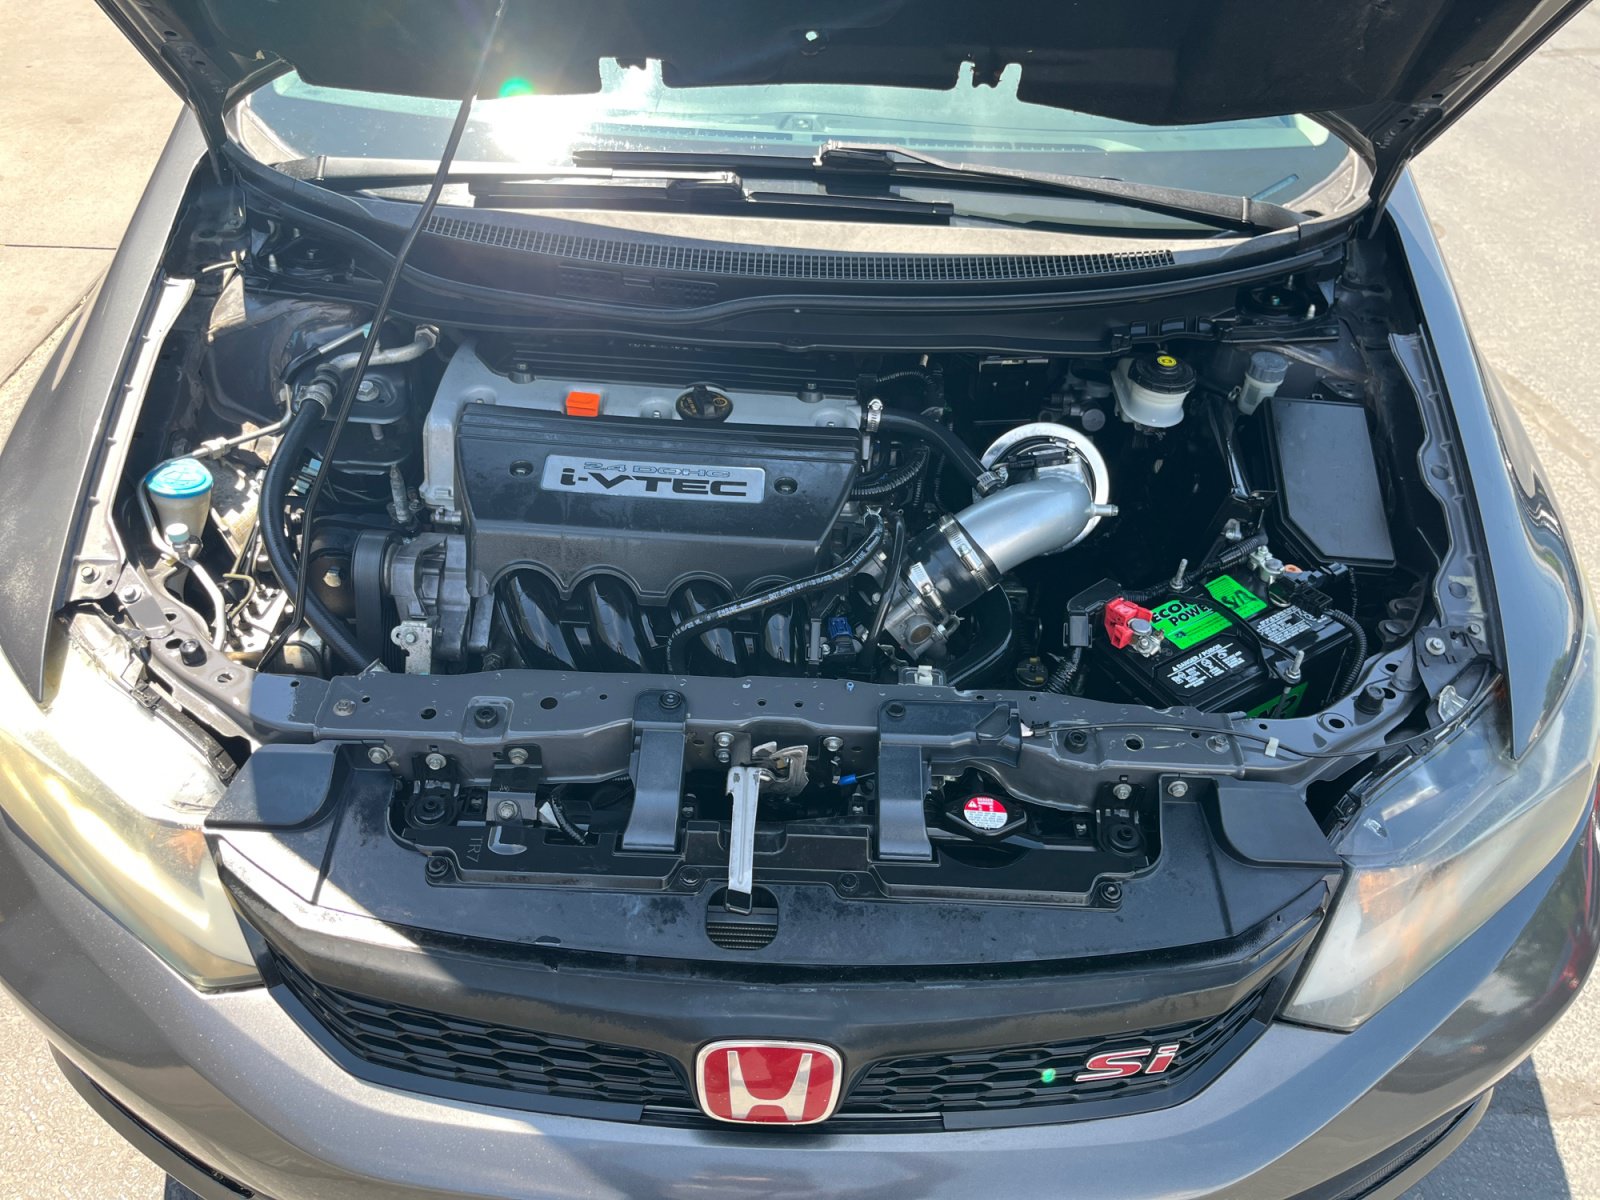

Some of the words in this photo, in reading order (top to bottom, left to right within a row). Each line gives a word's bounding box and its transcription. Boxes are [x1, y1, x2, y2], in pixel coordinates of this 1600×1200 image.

[560, 467, 748, 497] i-VTEC
[583, 461, 627, 473] 2.4
[632, 464, 730, 478] DOHC
[1168, 604, 1214, 626] POWE
[1075, 1043, 1180, 1082] Si
